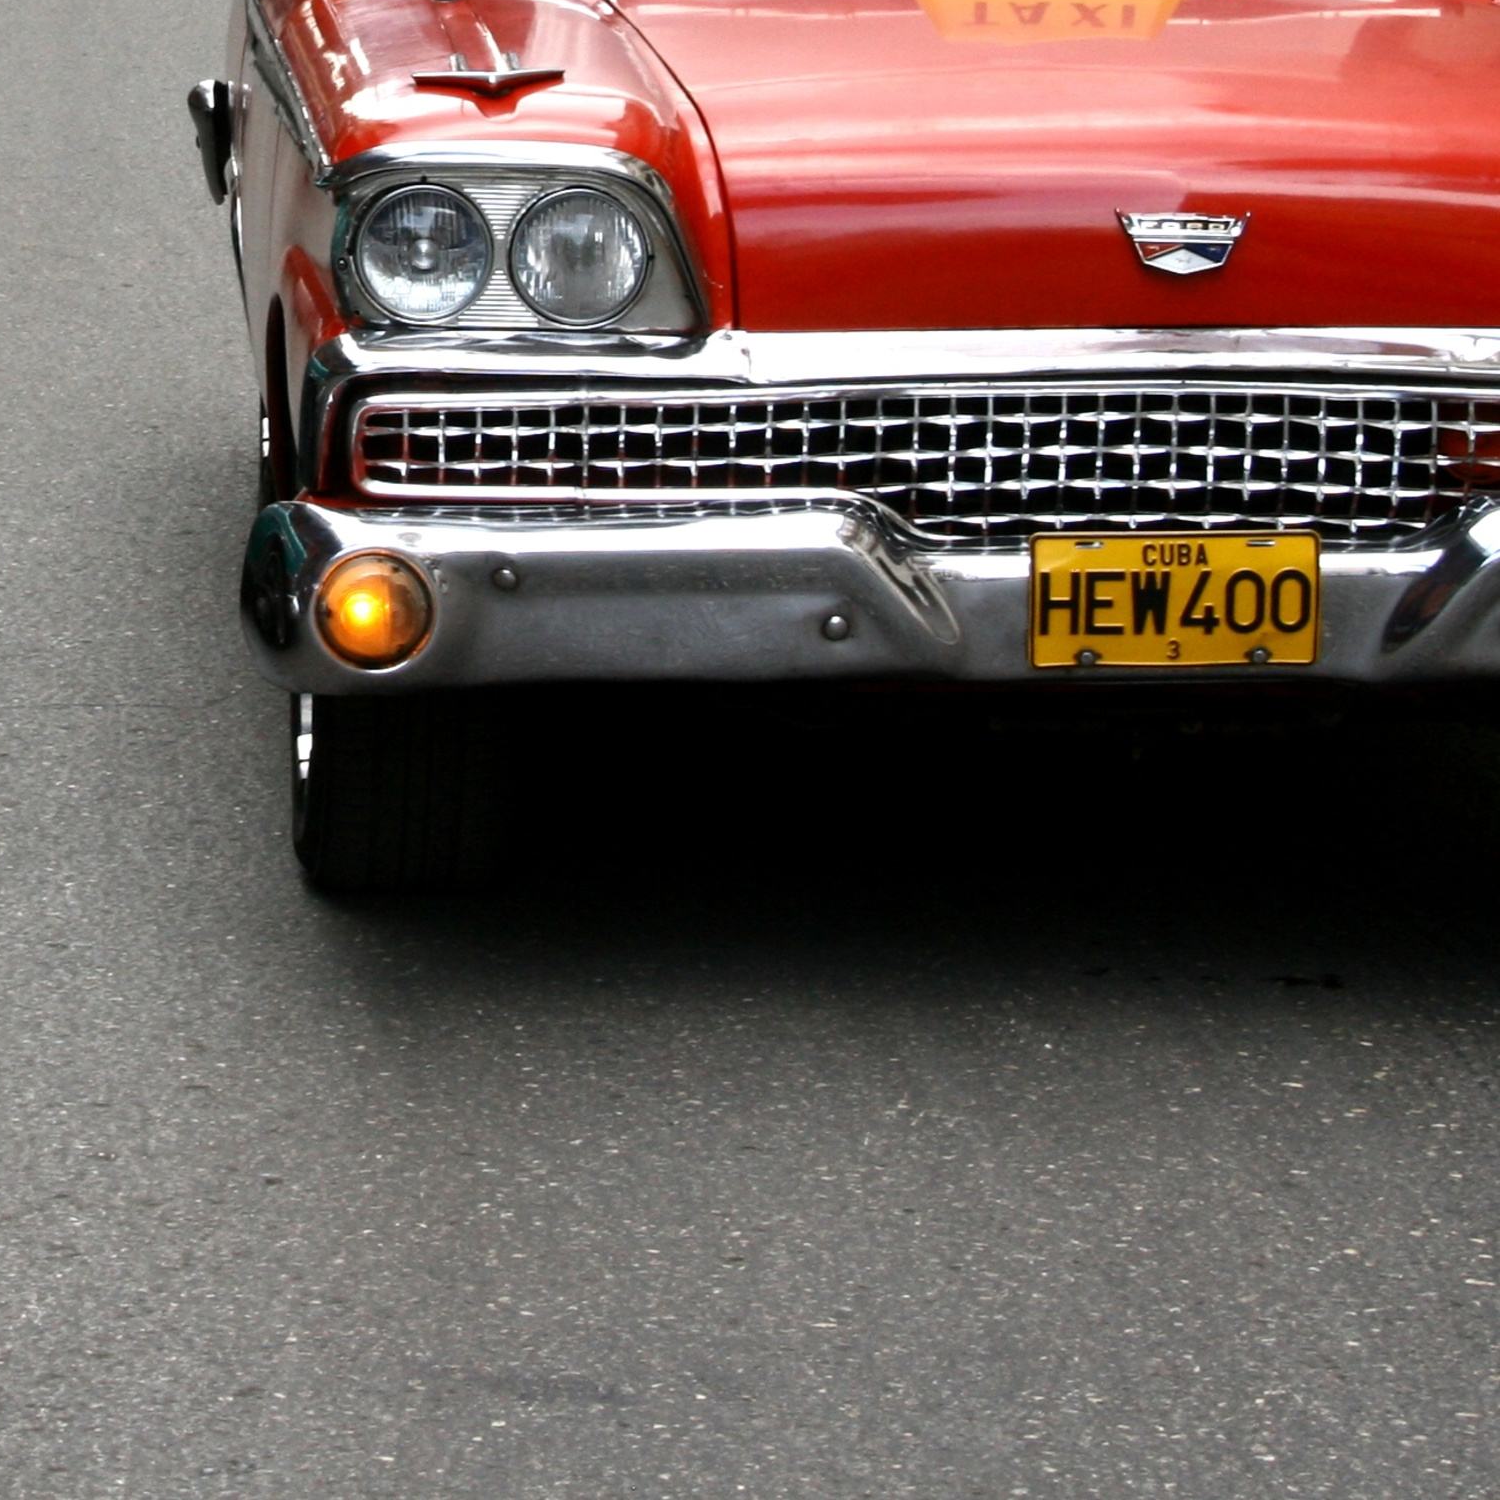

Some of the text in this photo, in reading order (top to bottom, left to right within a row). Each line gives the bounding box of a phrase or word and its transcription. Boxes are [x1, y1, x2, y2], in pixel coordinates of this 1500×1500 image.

[1141, 542, 1209, 567] CUBA
[1038, 567, 1312, 635] HEW400
[1166, 638, 1182, 660] 3
